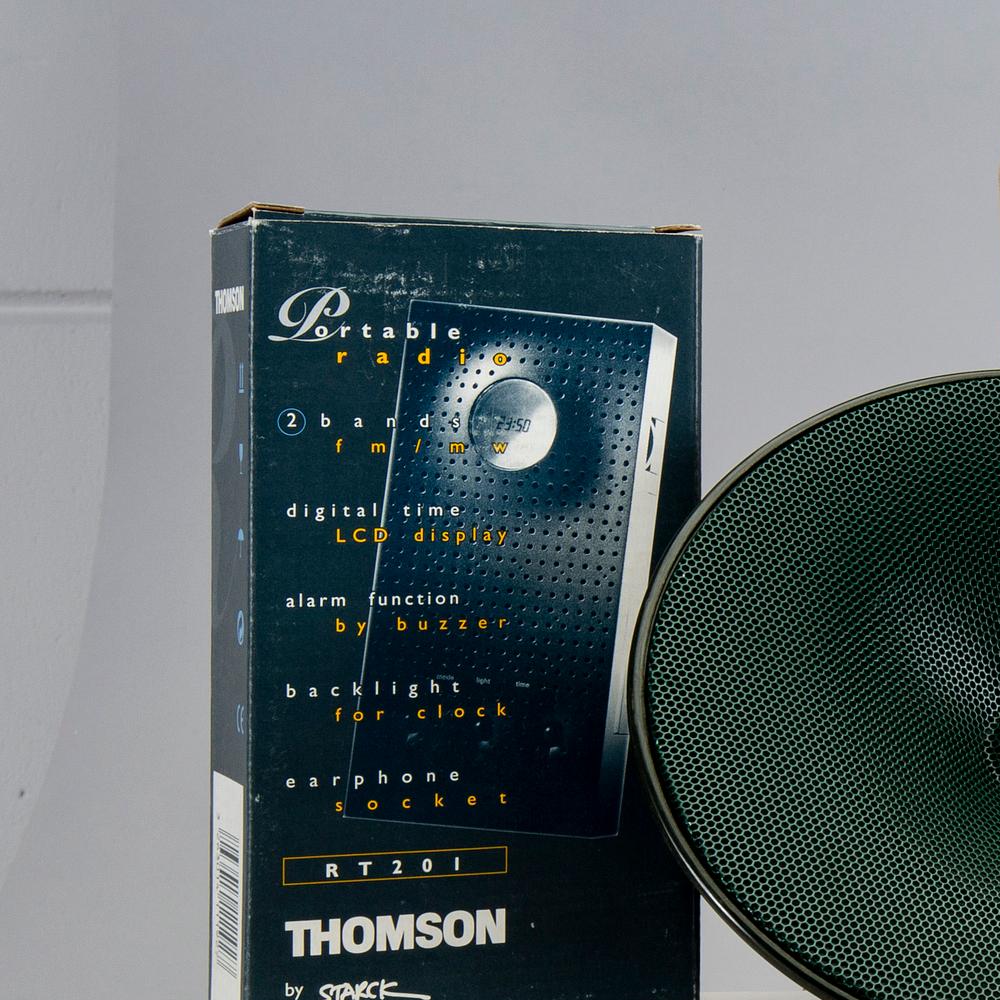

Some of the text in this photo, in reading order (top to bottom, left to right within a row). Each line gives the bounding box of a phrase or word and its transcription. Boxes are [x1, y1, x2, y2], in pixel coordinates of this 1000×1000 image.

[215, 286, 244, 314] THOMSON
[268, 286, 461, 342] Portable
[336, 348, 508, 367] radio
[286, 411, 461, 429] 2 bands
[286, 502, 461, 522] digital time
[336, 527, 508, 546] LCD display
[286, 591, 460, 608] alarm function
[336, 616, 508, 637] by buzzer
[286, 680, 461, 699] backlight
[335, 703, 508, 722] for clock
[286, 770, 461, 790] earphone
[335, 793, 508, 813] socket
[284, 908, 507, 958] THOMSON
[285, 982, 304, 1000] by
